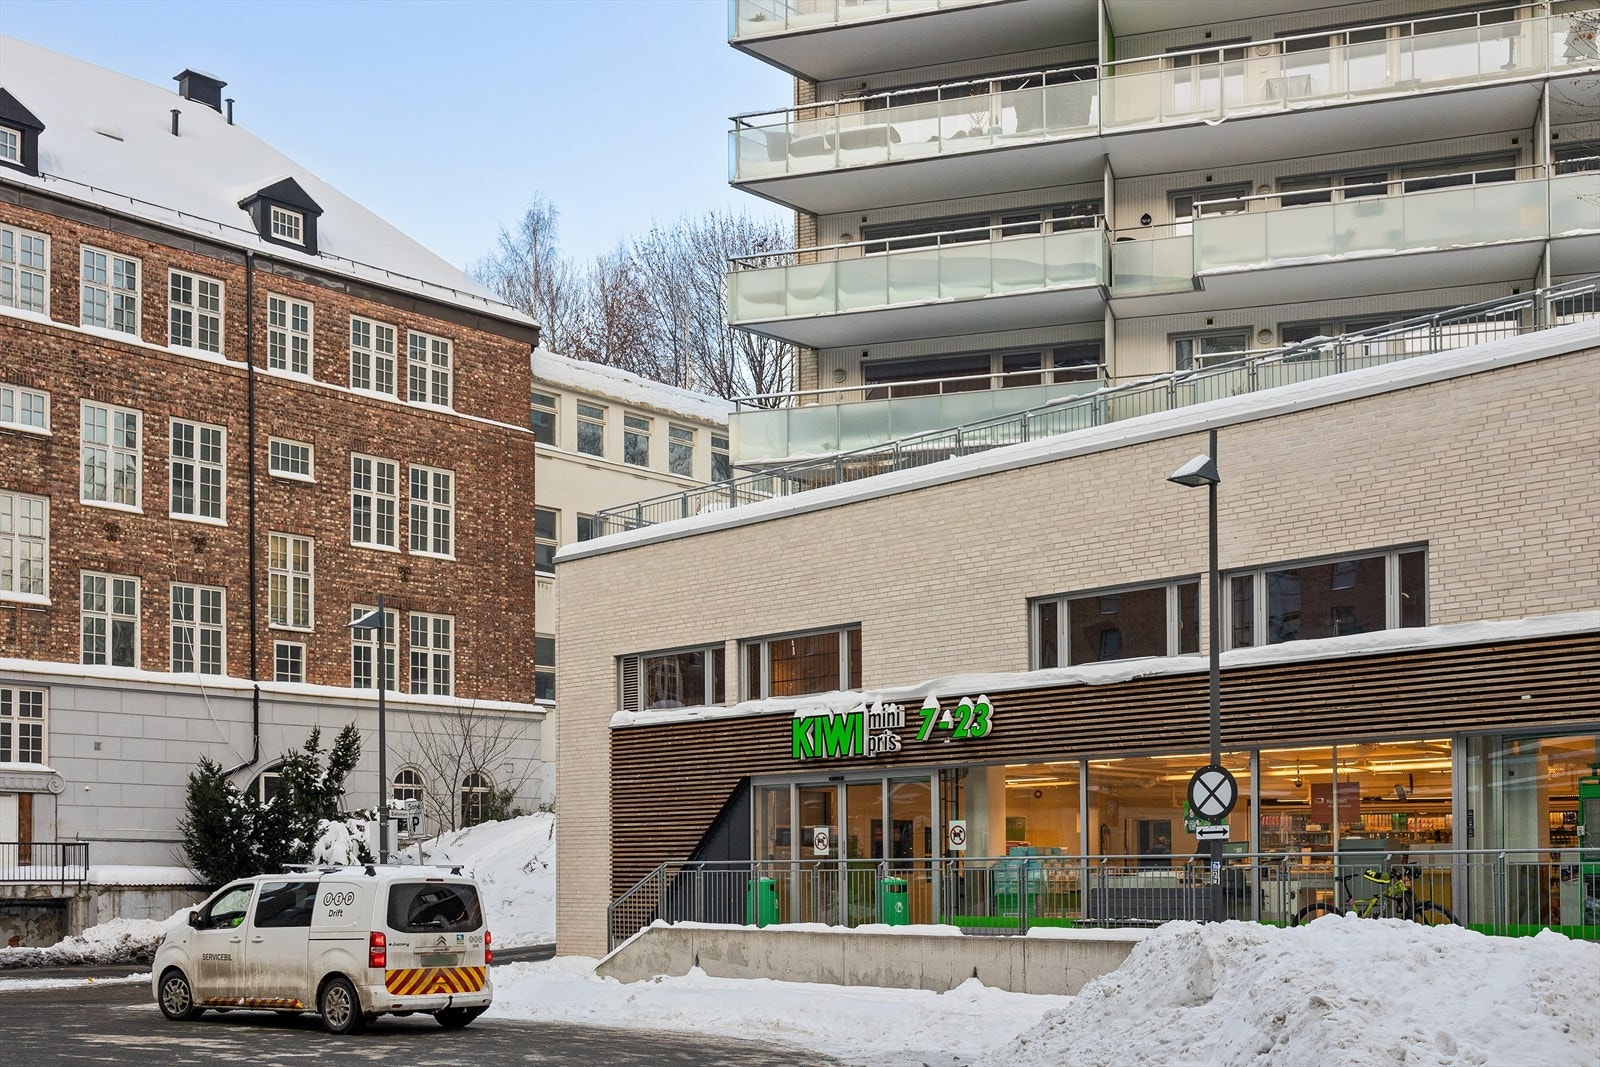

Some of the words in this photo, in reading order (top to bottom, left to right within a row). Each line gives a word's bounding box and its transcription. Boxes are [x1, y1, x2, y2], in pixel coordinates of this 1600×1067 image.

[868, 705, 900, 729] mini
[791, 711, 865, 759] KIWI
[868, 732, 897, 753] pris
[412, 817, 420, 832] P
[328, 909, 343, 917] Drift
[202, 953, 233, 961] SERVICEBIL
